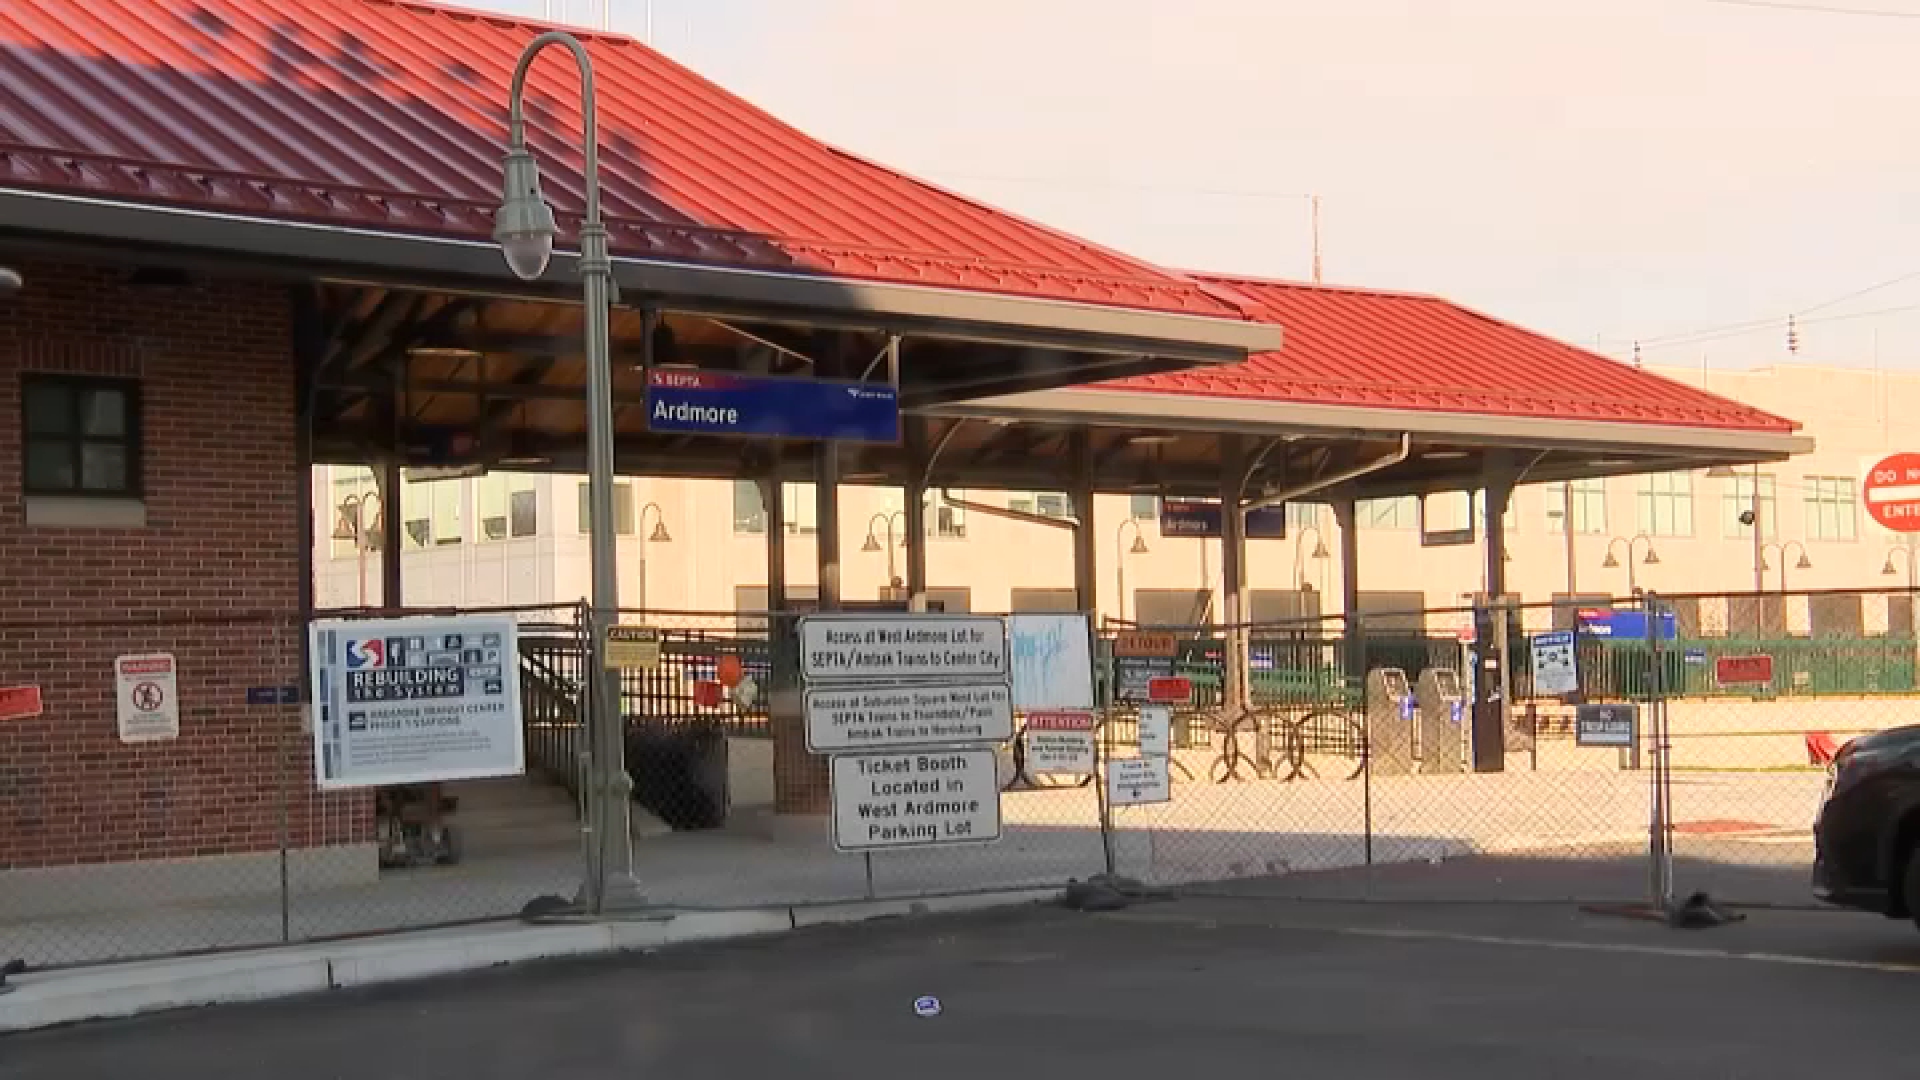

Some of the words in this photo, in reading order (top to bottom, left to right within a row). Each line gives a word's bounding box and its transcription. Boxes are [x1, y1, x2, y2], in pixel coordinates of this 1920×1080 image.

[666, 373, 701, 388] SEPTA
[653, 399, 738, 425] Ardmore
[1873, 469, 1897, 485] DO
[609, 629, 657, 642] CAUTION
[826, 628, 862, 645] Access
[864, 628, 875, 644] at
[877, 627, 902, 644] West
[904, 627, 948, 644] Ardmore
[951, 627, 968, 643] Lot
[1121, 636, 1171, 650] DETOUR
[896, 650, 929, 666] Trains
[930, 650, 942, 665] to
[944, 650, 977, 666] Center
[980, 650, 1001, 668] City
[354, 666, 460, 688] REBUILDING
[354, 685, 385, 700] the
[394, 683, 460, 700] System
[466, 702, 505, 714] CENTER
[832, 711, 864, 726] SEPTA
[868, 710, 898, 723] Trains
[1030, 715, 1090, 729] ATTENTION
[857, 757, 911, 776] Ticket
[916, 755, 969, 772] Booth
[871, 777, 941, 797] Located
[946, 778, 964, 793] in
[857, 801, 897, 818] West
[904, 799, 980, 816] Ardmore
[868, 822, 938, 841] Parking
[944, 819, 972, 837] Lot
